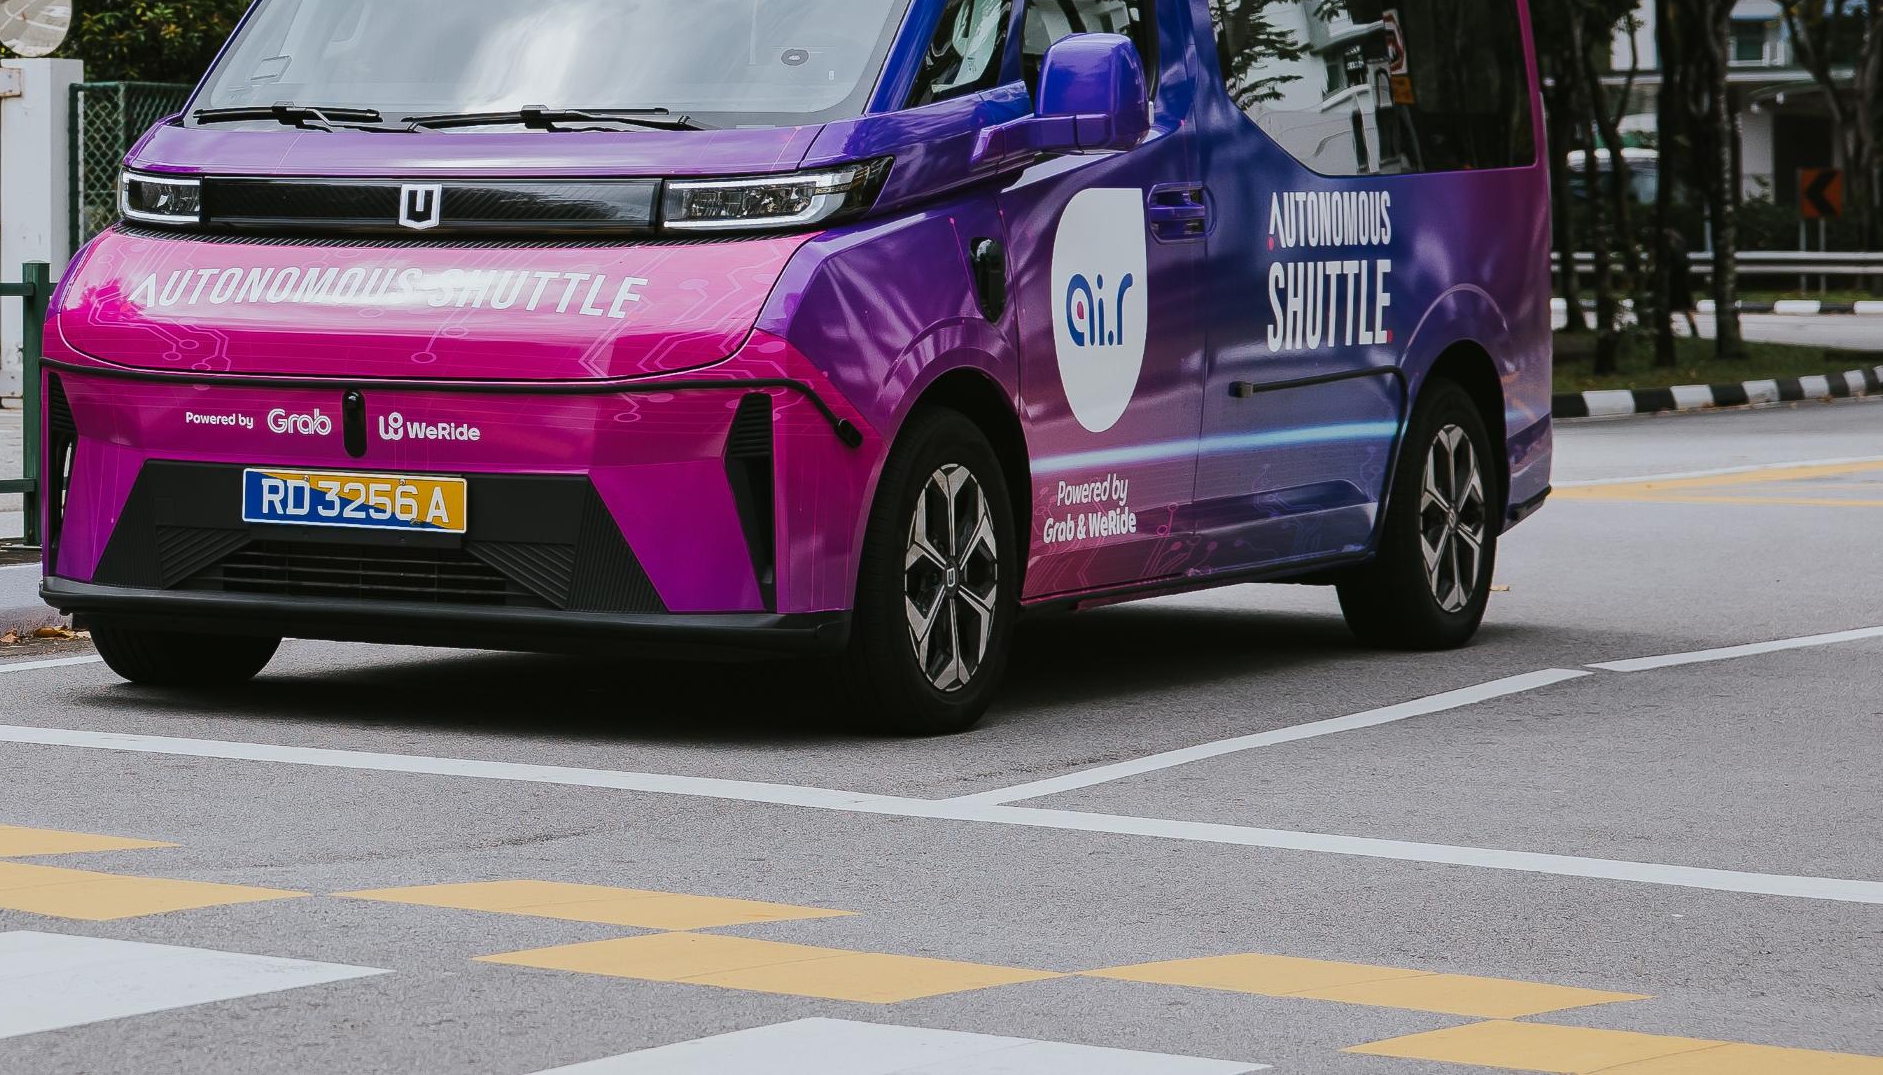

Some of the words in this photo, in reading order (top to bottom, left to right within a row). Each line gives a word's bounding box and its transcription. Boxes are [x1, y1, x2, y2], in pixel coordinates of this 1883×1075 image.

[1268, 190, 1392, 251] AUTONOMOUS
[128, 266, 424, 308] AUTONOMOUS
[185, 411, 236, 426] Powered
[238, 413, 254, 429] by
[267, 408, 332, 436] Grab
[406, 421, 481, 441] WeRide
[261, 478, 311, 516] RD
[317, 480, 419, 522] 3256
[426, 486, 449, 523] A
[1057, 473, 1111, 506] Powered
[1112, 473, 1129, 506] by
[1043, 513, 1075, 544] Grab
[1076, 513, 1087, 540] &
[1088, 506, 1137, 538] WeRide
